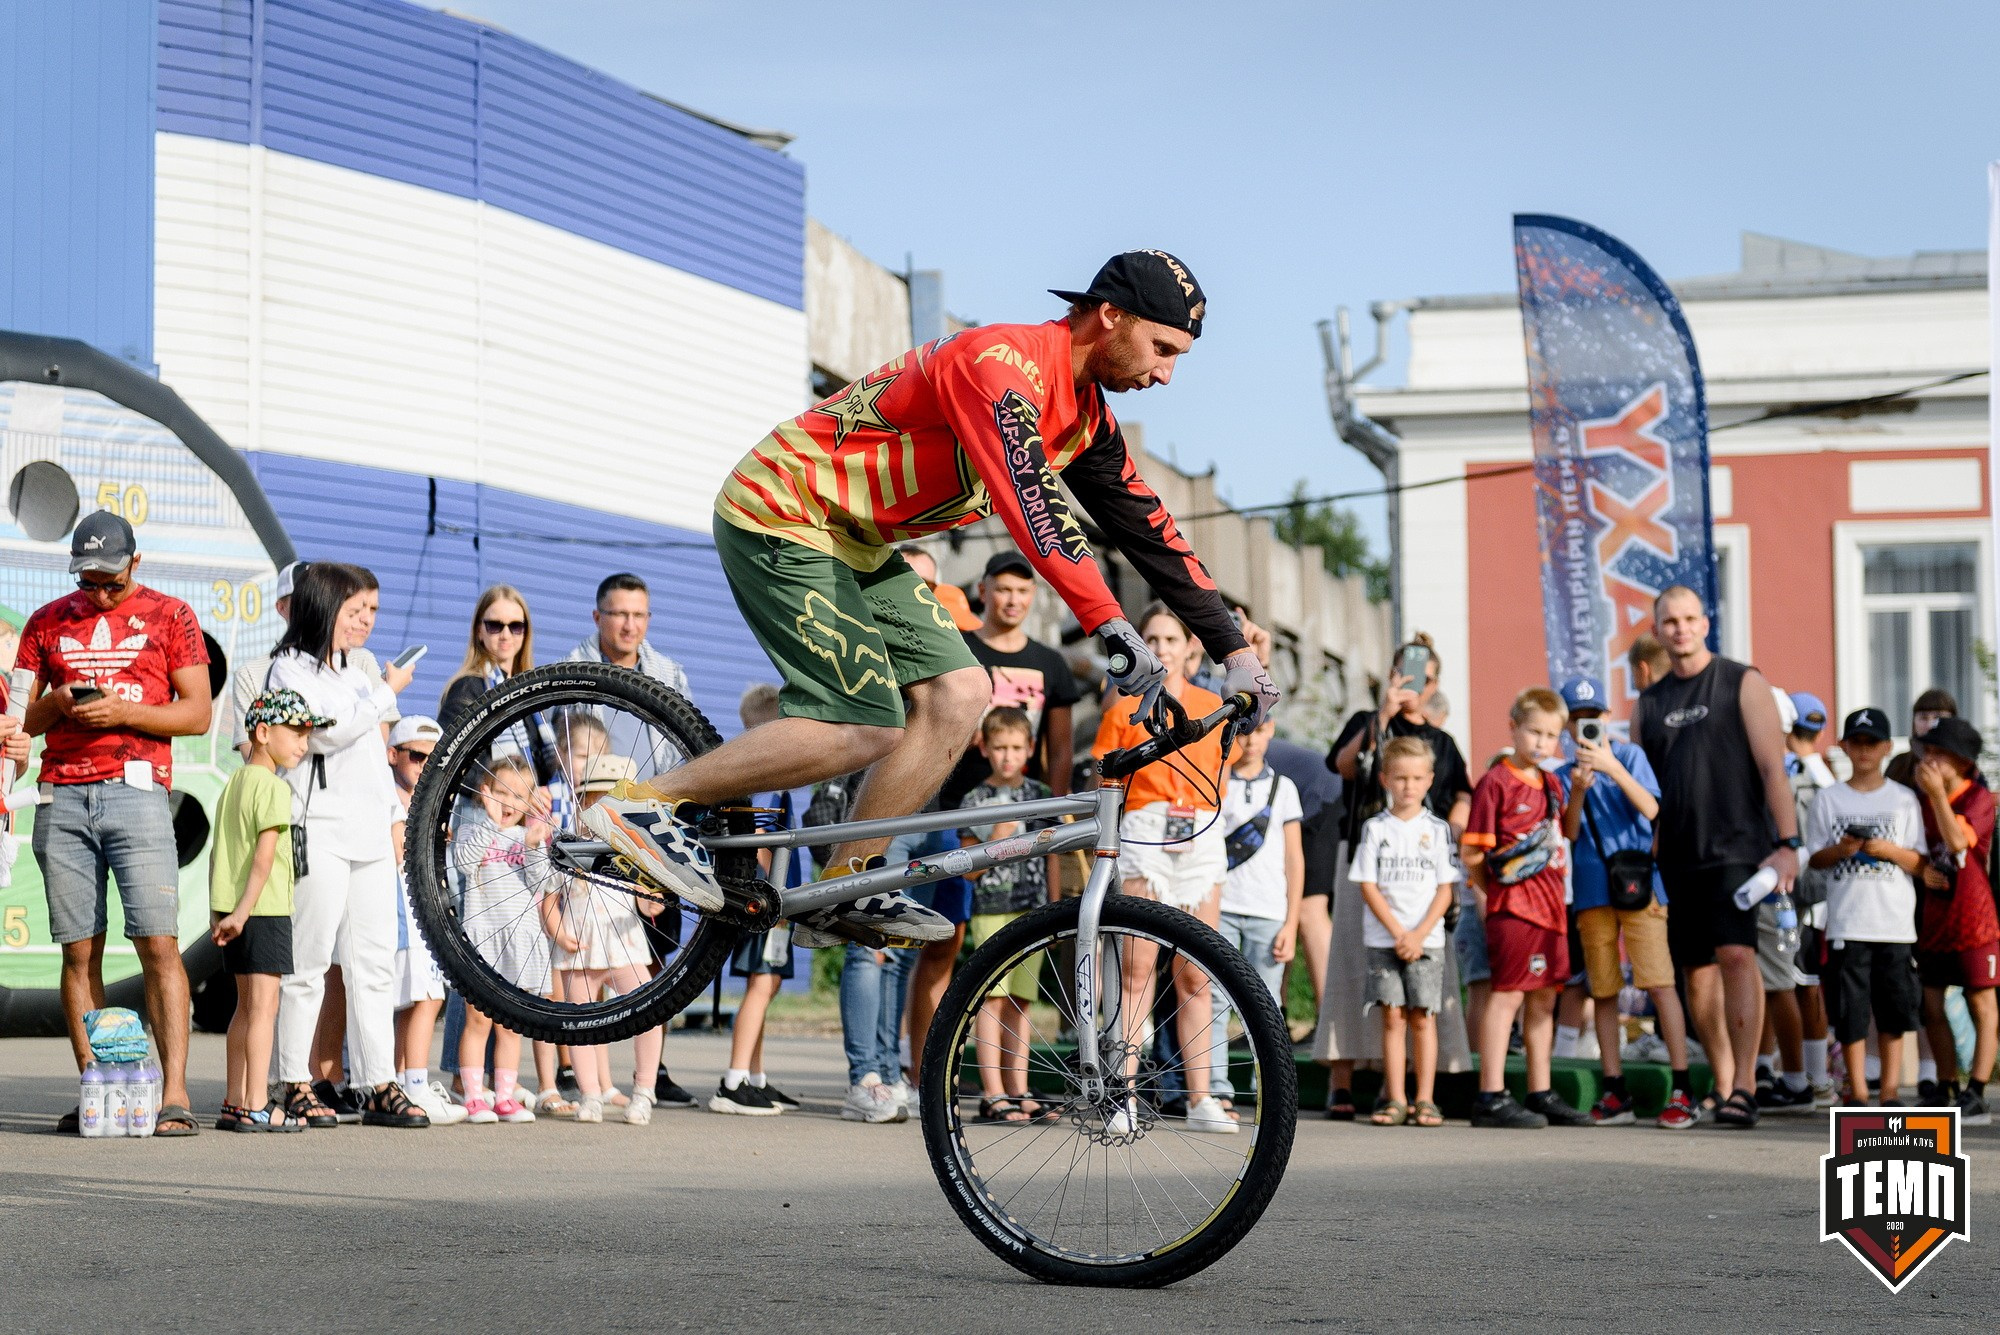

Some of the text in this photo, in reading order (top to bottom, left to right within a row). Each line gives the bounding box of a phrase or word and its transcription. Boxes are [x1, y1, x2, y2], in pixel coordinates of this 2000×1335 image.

[96, 483, 148, 527] 50
[1022, 485, 1062, 552] DRINK
[211, 578, 262, 624] 30
[448, 708, 488, 757] MICHELIN
[577, 1009, 632, 1028] MICHELIN
[955, 1180, 975, 1209] Country
[972, 1208, 1013, 1246] MICHELIN
